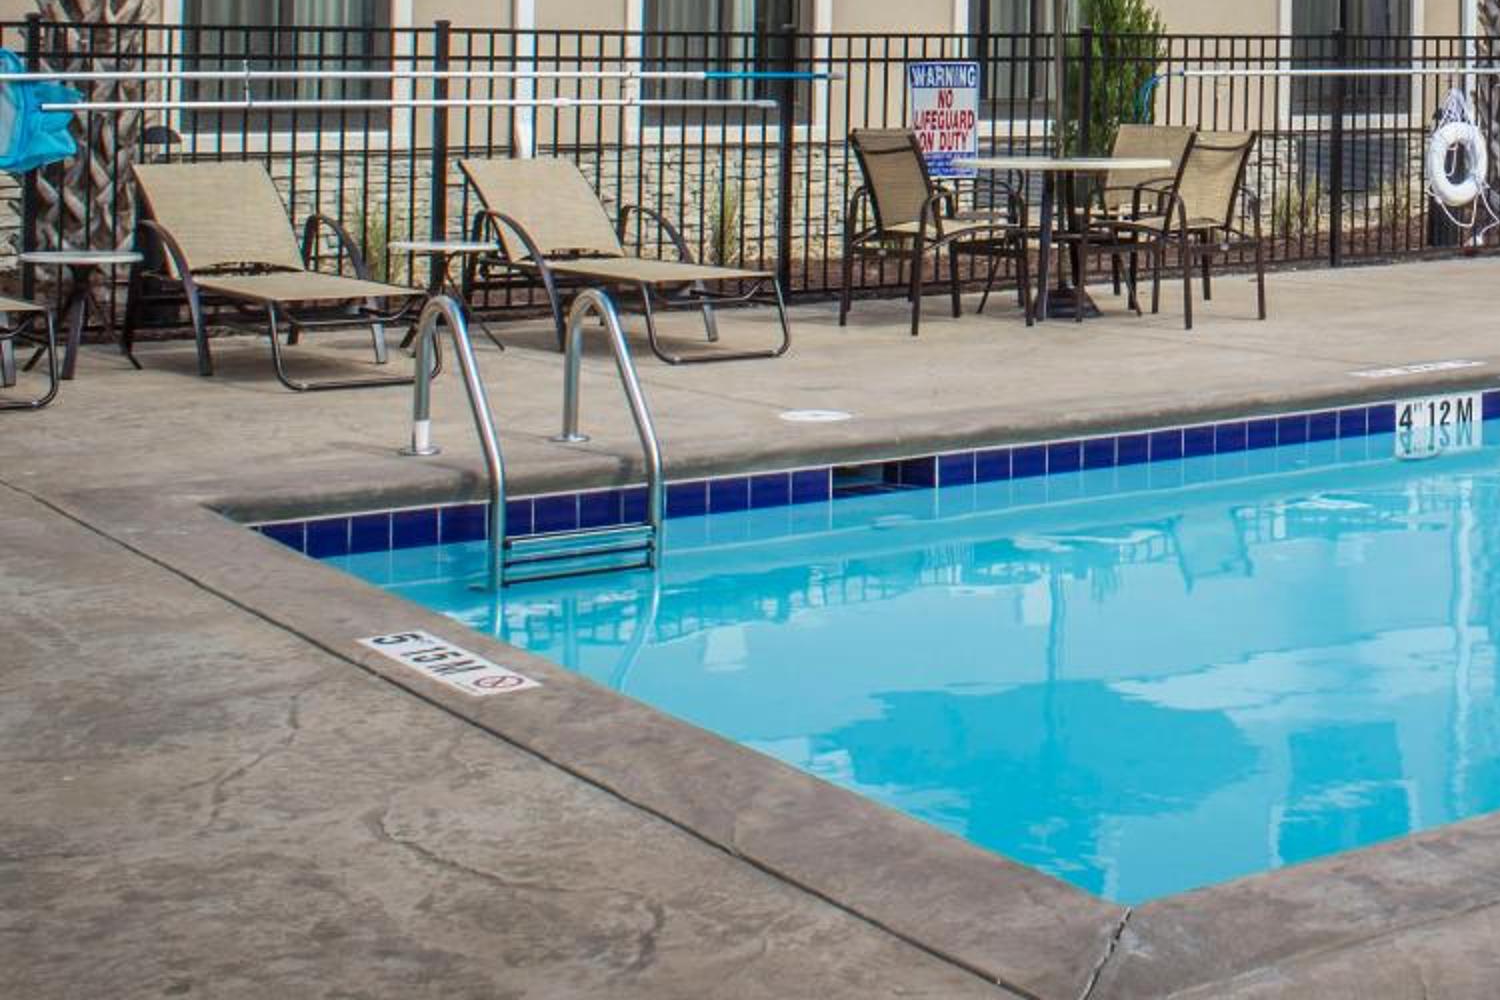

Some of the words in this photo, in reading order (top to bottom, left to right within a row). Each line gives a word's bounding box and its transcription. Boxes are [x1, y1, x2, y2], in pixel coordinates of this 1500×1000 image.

[911, 65, 977, 87] WARNING
[938, 89, 953, 109] NO
[913, 110, 975, 130] LIFEGUARD
[920, 132, 934, 151] ON
[939, 132, 969, 151] DUTY
